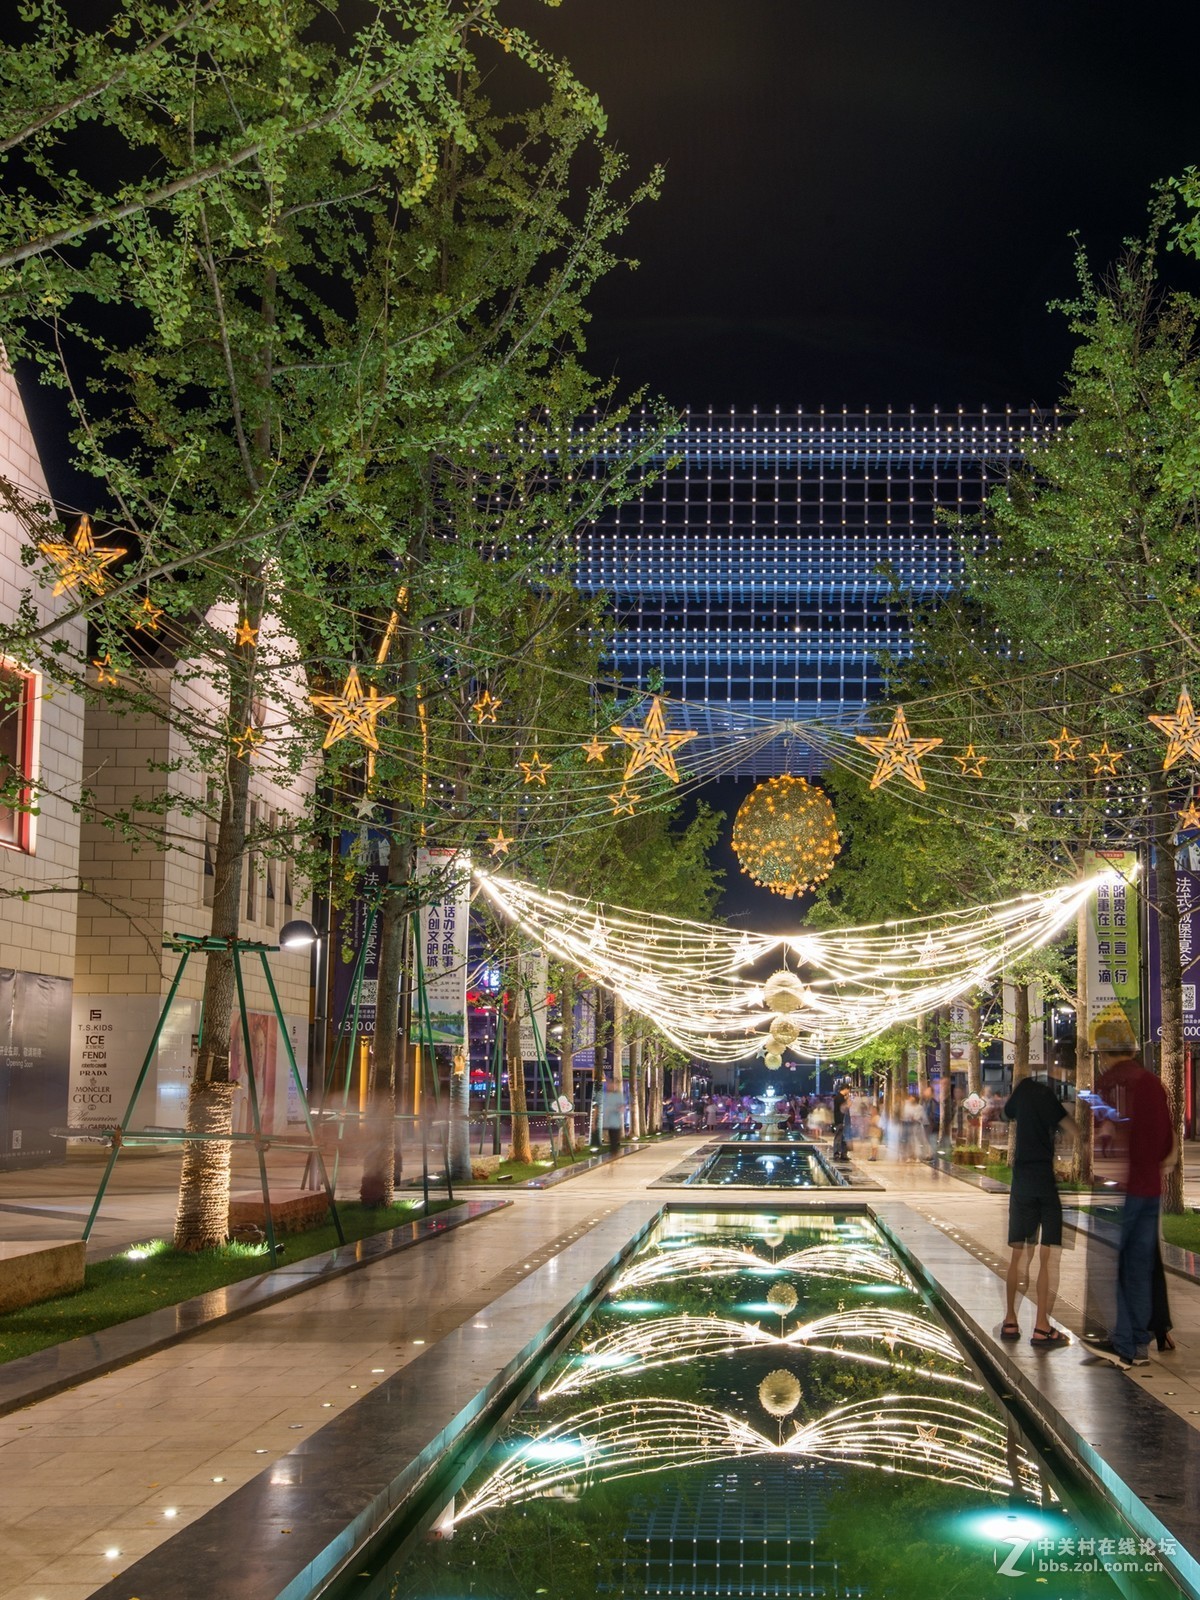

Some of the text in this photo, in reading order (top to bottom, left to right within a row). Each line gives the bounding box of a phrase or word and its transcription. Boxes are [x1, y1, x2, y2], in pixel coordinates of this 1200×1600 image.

[1097, 870, 1111, 984] 保重在一点一滴
[78, 1024, 113, 1032] T.S.KIDS
[86, 1035, 105, 1045] ICE
[82, 1051, 107, 1059] FENDI
[72, 1094, 112, 1104] GUCCI
